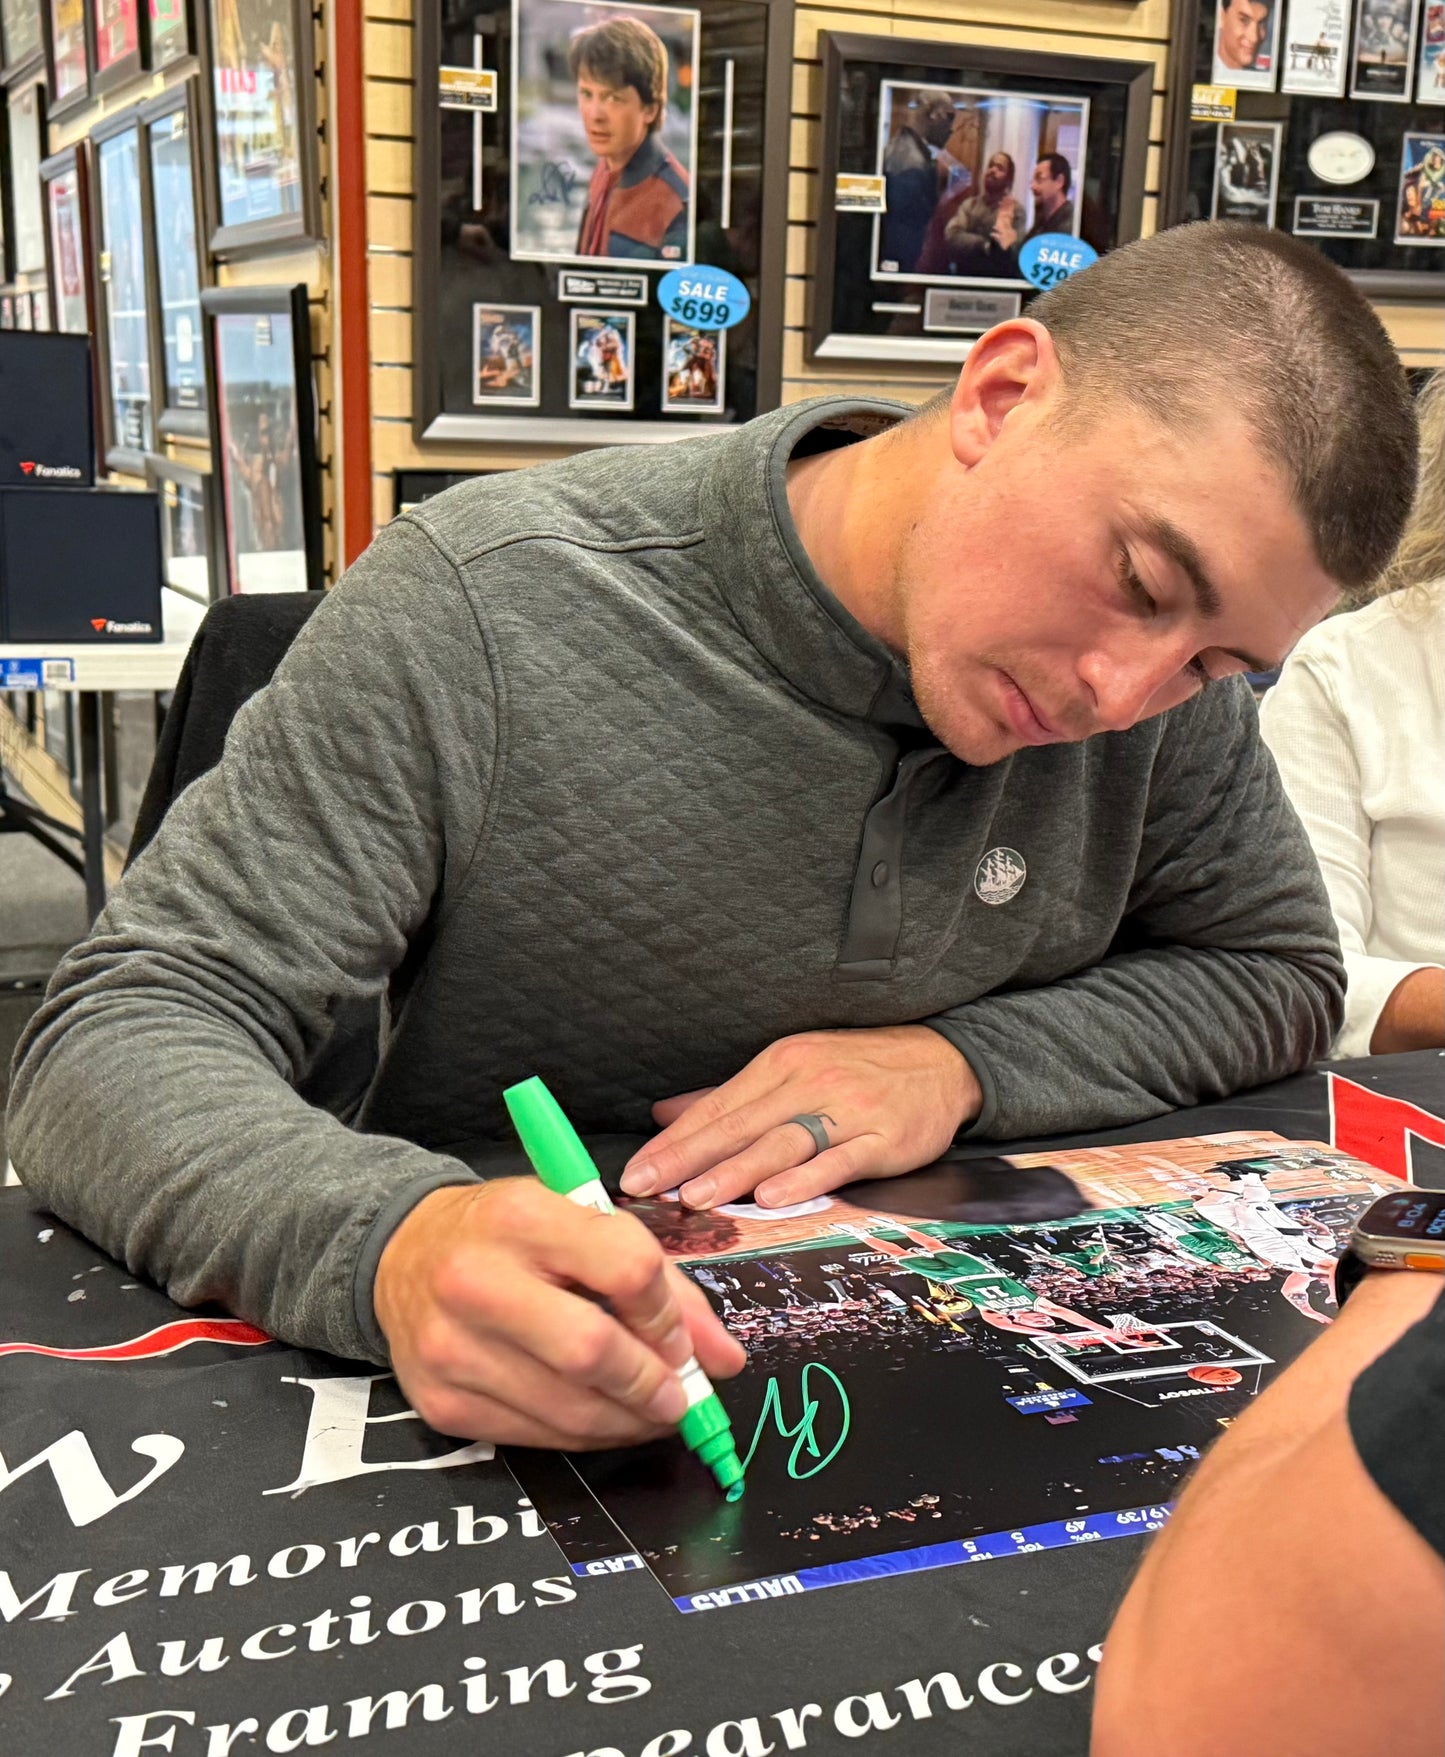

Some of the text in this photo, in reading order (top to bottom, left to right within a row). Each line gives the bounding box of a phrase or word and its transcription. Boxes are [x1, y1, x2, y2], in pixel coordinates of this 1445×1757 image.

[1037, 247, 1083, 268] SALE
[678, 280, 729, 301] SALE
[671, 296, 731, 326] $699
[35, 463, 82, 478] Fanatics
[106, 620, 152, 634] Fanatics
[975, 1285, 1009, 1299] 11
[1065, 1521, 1086, 1533] 49
[1010, 1531, 1025, 1543] 5
[962, 1540, 977, 1553] 5
[44, 1576, 578, 1701] Auctions
[110, 1644, 653, 1757] Framing
